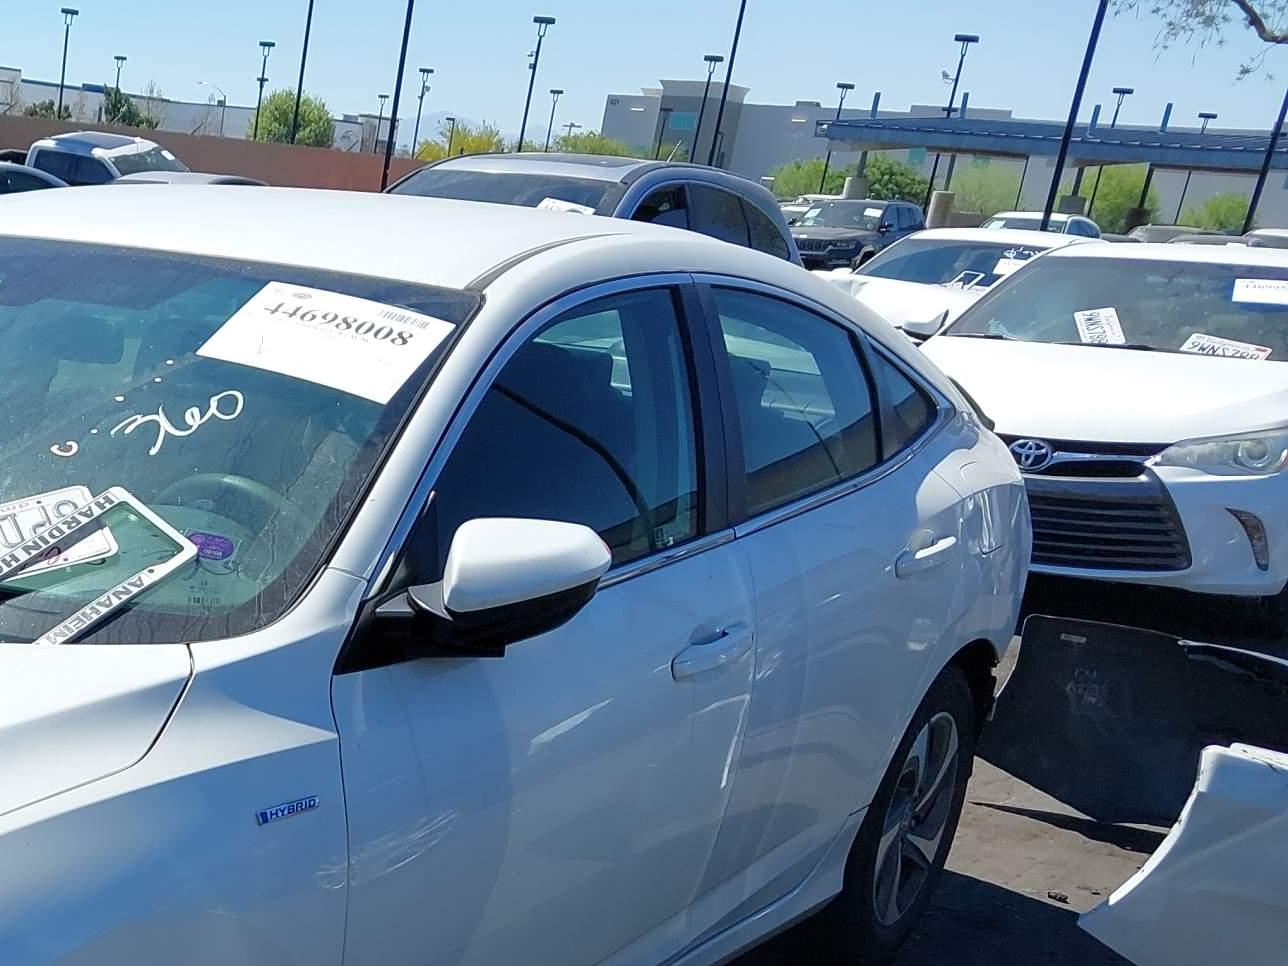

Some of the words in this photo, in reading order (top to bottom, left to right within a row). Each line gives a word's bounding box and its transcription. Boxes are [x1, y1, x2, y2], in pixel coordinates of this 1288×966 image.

[264, 302, 414, 346] 44698008
[25, 494, 117, 556] HARDIN
[44, 575, 146, 646] ANAHEIM
[269, 798, 316, 820] HYBRID
